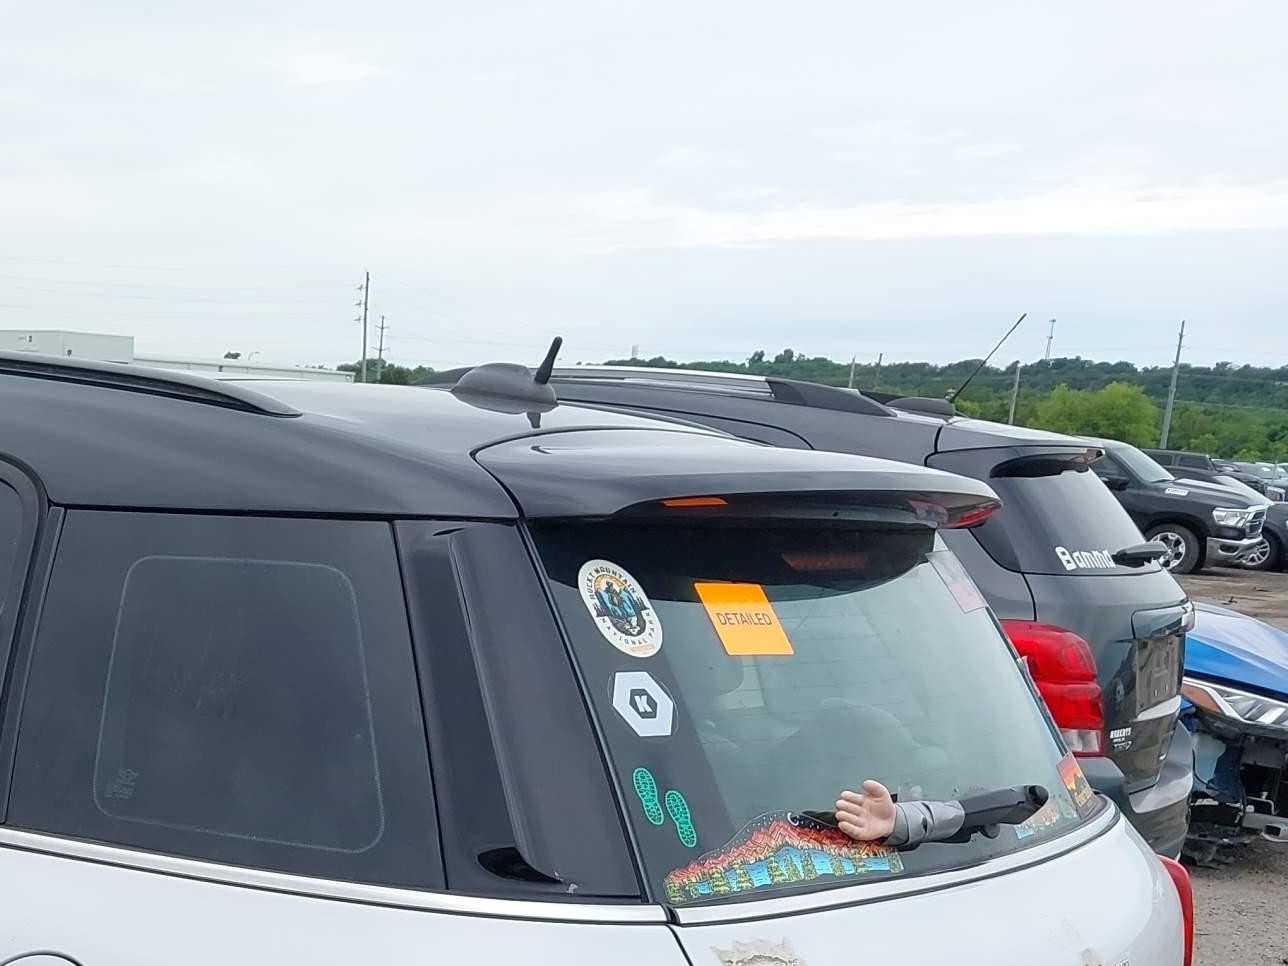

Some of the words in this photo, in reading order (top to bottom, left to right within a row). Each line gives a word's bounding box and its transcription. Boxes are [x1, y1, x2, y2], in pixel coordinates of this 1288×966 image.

[594, 566, 637, 594] MOUNTAIN
[715, 612, 773, 626] DETAILED
[600, 617, 648, 645] NATIONAL
[634, 695, 653, 713] K
